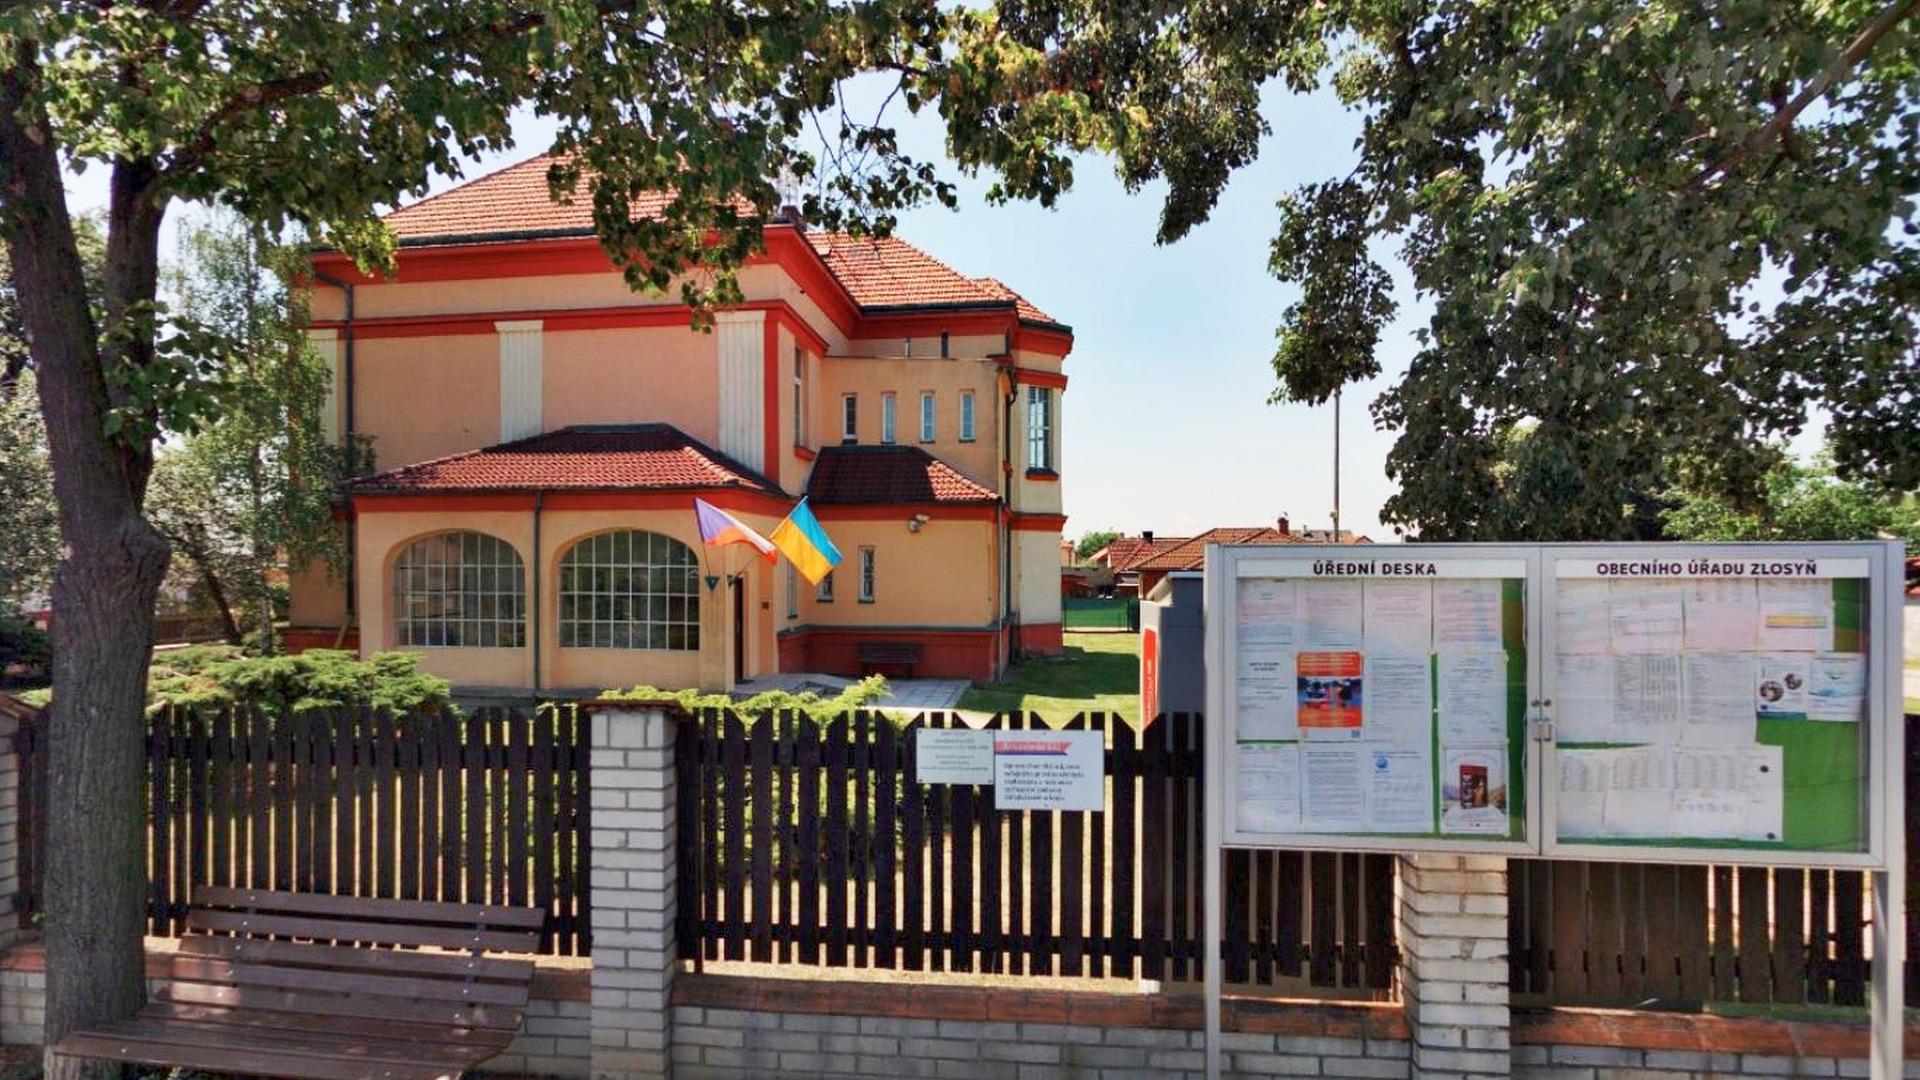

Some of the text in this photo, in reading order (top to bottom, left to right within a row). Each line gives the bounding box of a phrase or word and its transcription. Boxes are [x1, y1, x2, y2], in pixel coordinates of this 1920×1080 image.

[1313, 559, 1436, 575] ÚŘEDNÍ DESKA
[1597, 559, 1817, 575] OBECNÍHO ÚŘADU ZLOSYŇ
